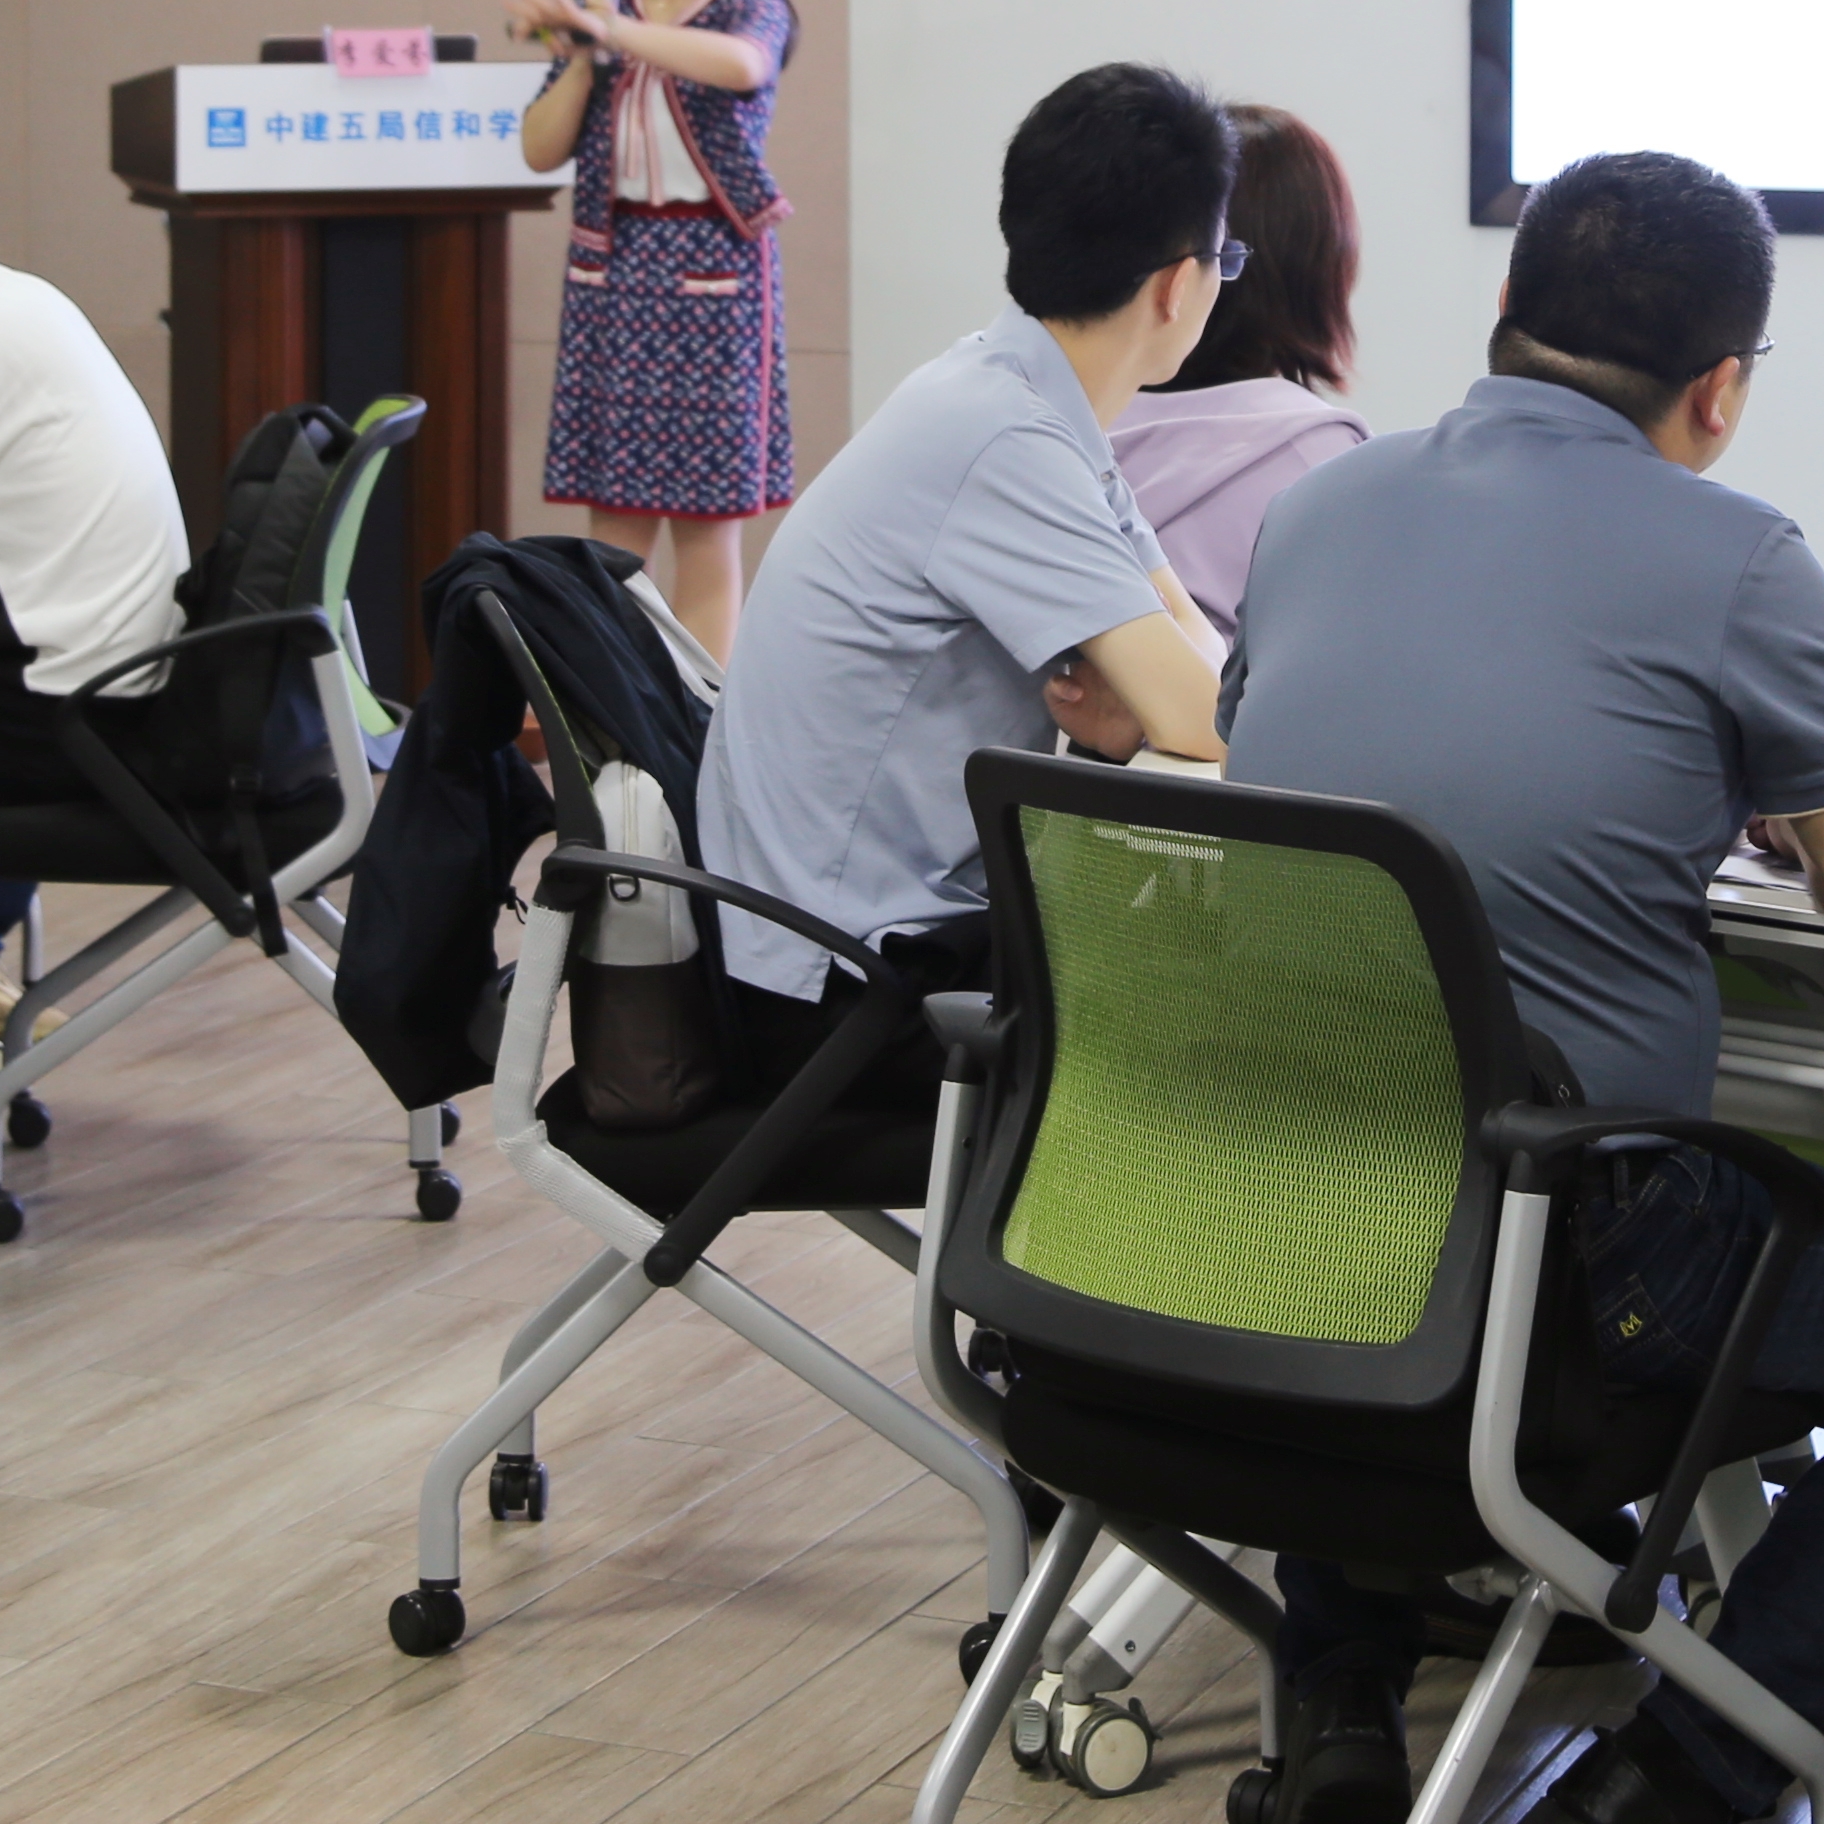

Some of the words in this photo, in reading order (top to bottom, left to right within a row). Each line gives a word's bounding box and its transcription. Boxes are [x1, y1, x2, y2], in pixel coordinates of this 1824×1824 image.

[265, 109, 518, 143] 中建五局信和学
